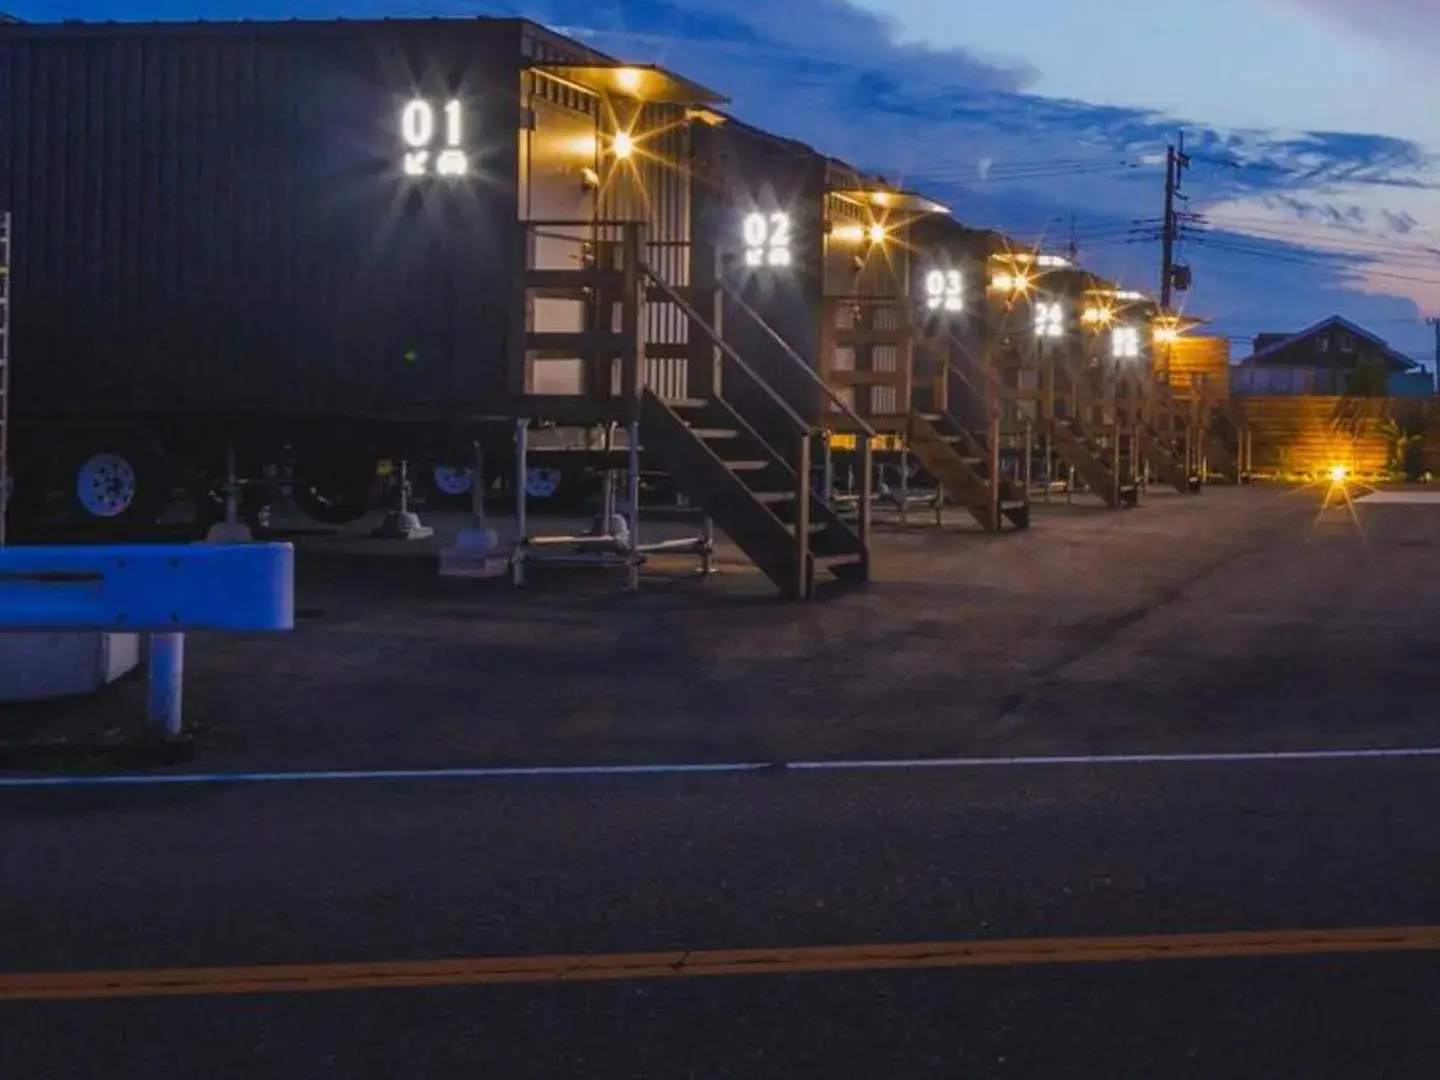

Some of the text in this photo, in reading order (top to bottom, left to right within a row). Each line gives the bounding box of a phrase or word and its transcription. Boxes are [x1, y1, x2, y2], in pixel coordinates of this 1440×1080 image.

[402, 99, 461, 147] 01
[743, 212, 790, 246] 02
[926, 270, 962, 295] 03
